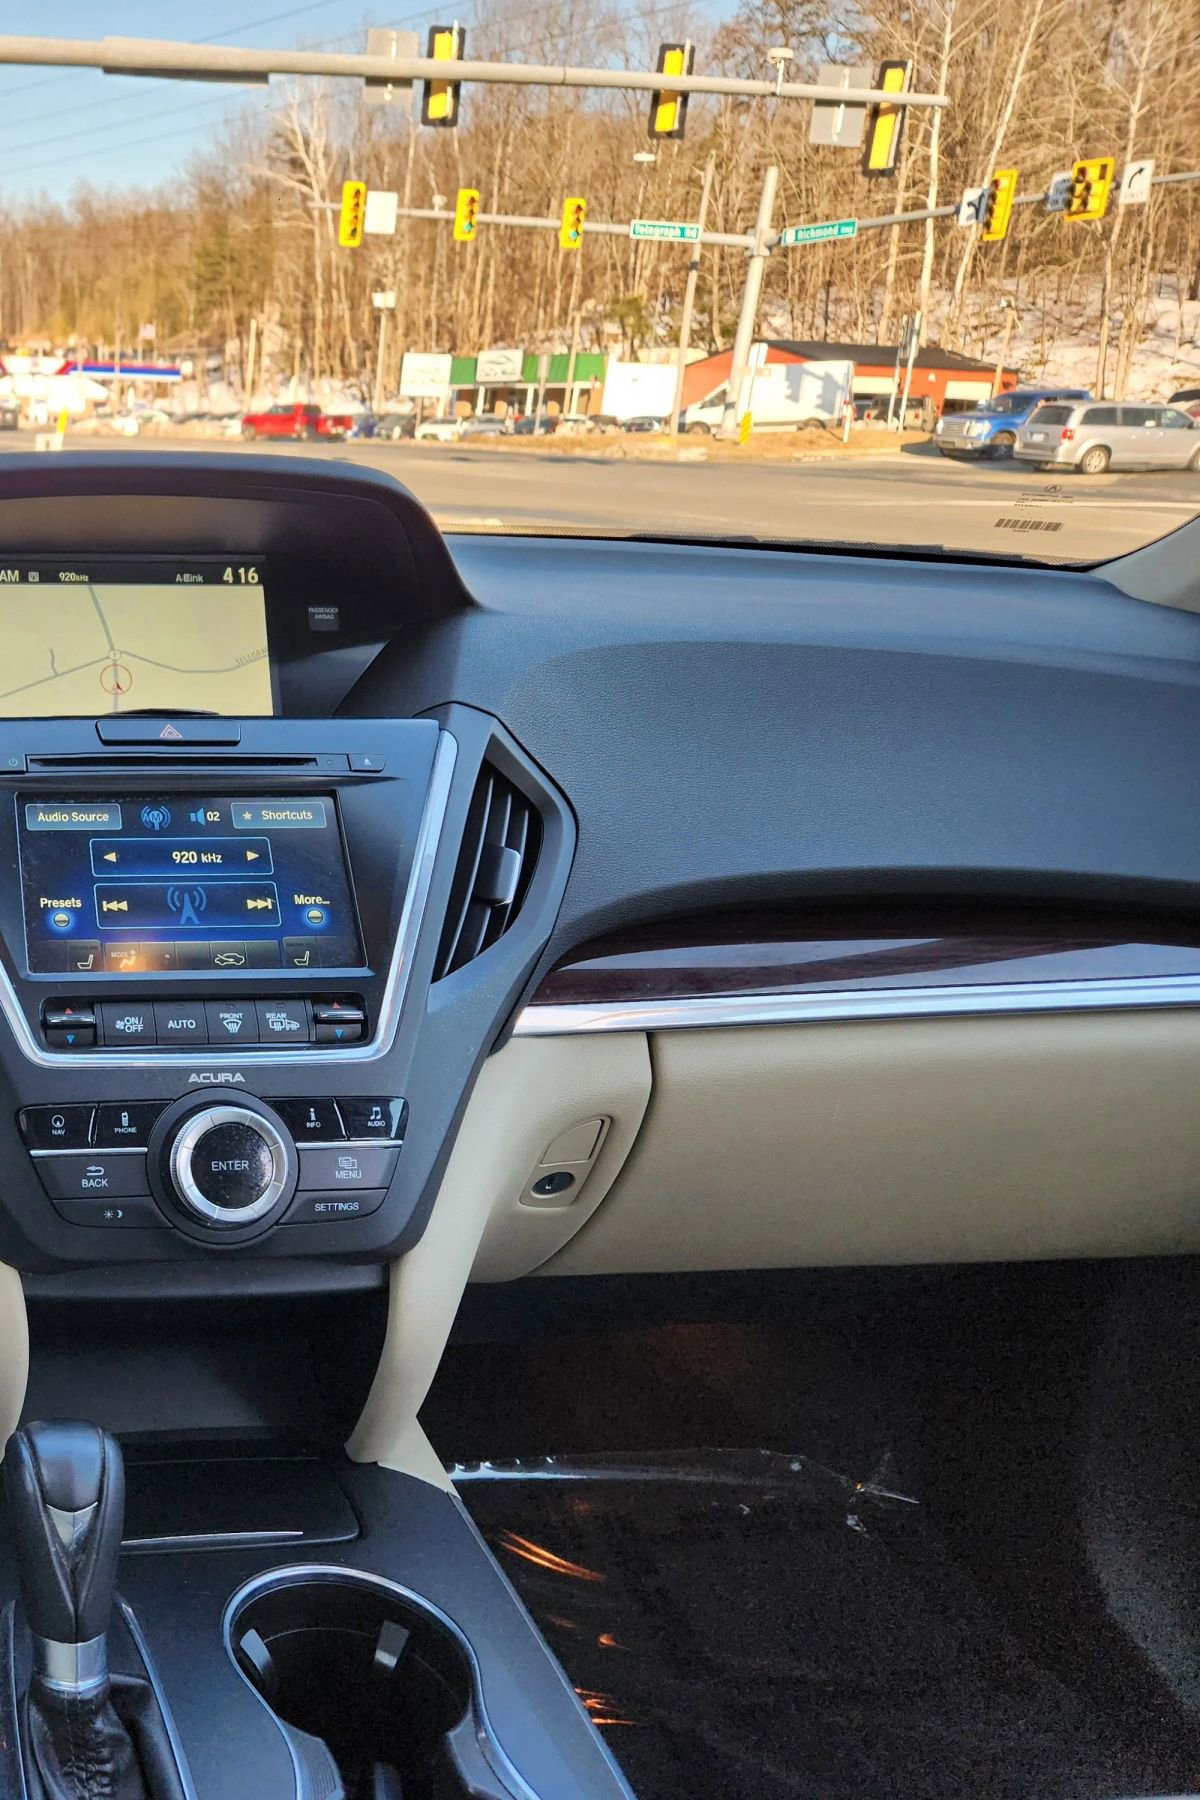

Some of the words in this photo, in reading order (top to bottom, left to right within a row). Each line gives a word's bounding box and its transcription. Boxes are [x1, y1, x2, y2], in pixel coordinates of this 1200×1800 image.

[797, 224, 838, 240] Richmond
[0, 570, 19, 582] AM
[38, 812, 69, 822] Audio
[71, 811, 109, 822] Source
[207, 812, 220, 822] 02
[261, 810, 313, 820] Shortcuts
[172, 851, 197, 863] 920
[201, 852, 222, 863] kHz
[40, 897, 82, 909] Presets
[125, 1024, 144, 1033] OFF
[167, 1019, 196, 1029] AUTO
[188, 1073, 245, 1083] ACURA
[211, 1160, 250, 1171] ENTER
[335, 1171, 362, 1179] MENU
[82, 1178, 108, 1187] BACK
[314, 1202, 360, 1212] SETTINGS
